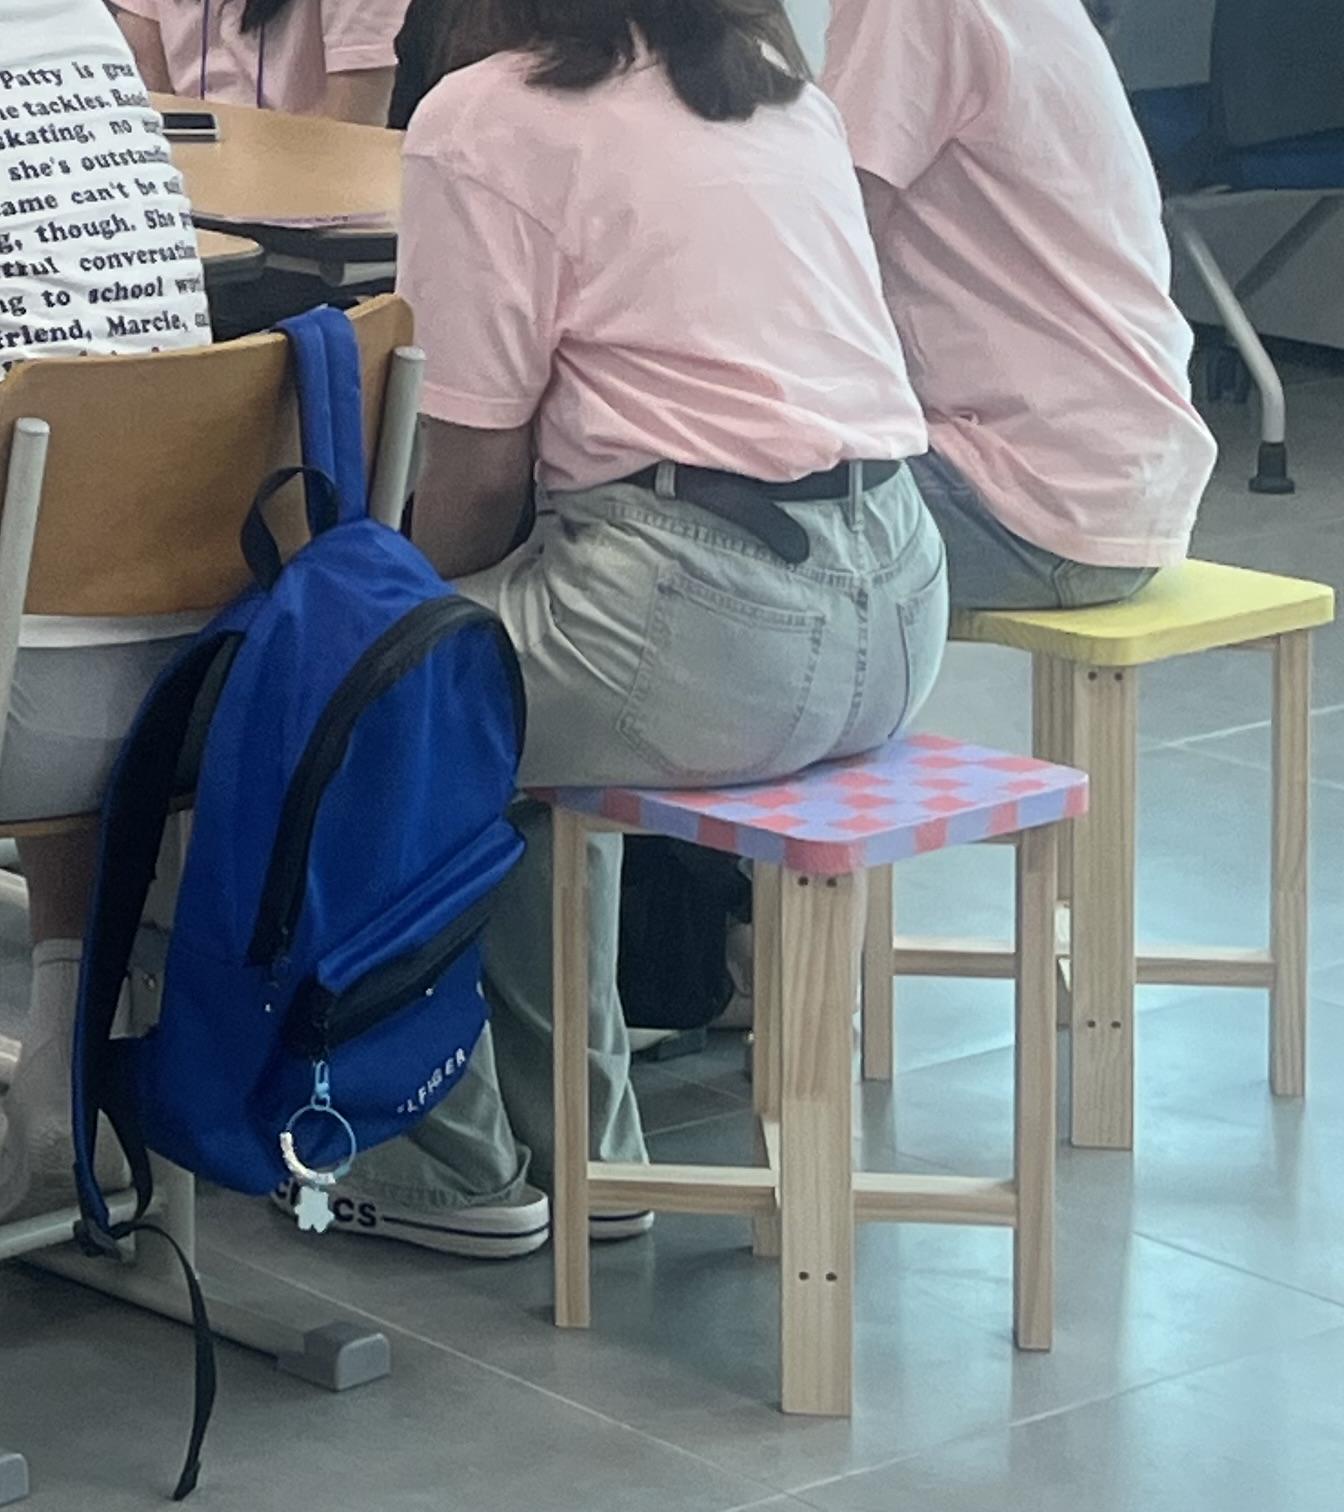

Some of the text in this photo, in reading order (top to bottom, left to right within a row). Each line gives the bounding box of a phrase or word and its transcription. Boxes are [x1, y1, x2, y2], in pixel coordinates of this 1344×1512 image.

[72, 61, 94, 80] is
[8, 157, 71, 181] she's
[71, 182, 130, 205] can't
[34, 214, 137, 242] though.
[144, 209, 176, 229] She
[42, 290, 71, 308] to
[88, 276, 164, 304] school
